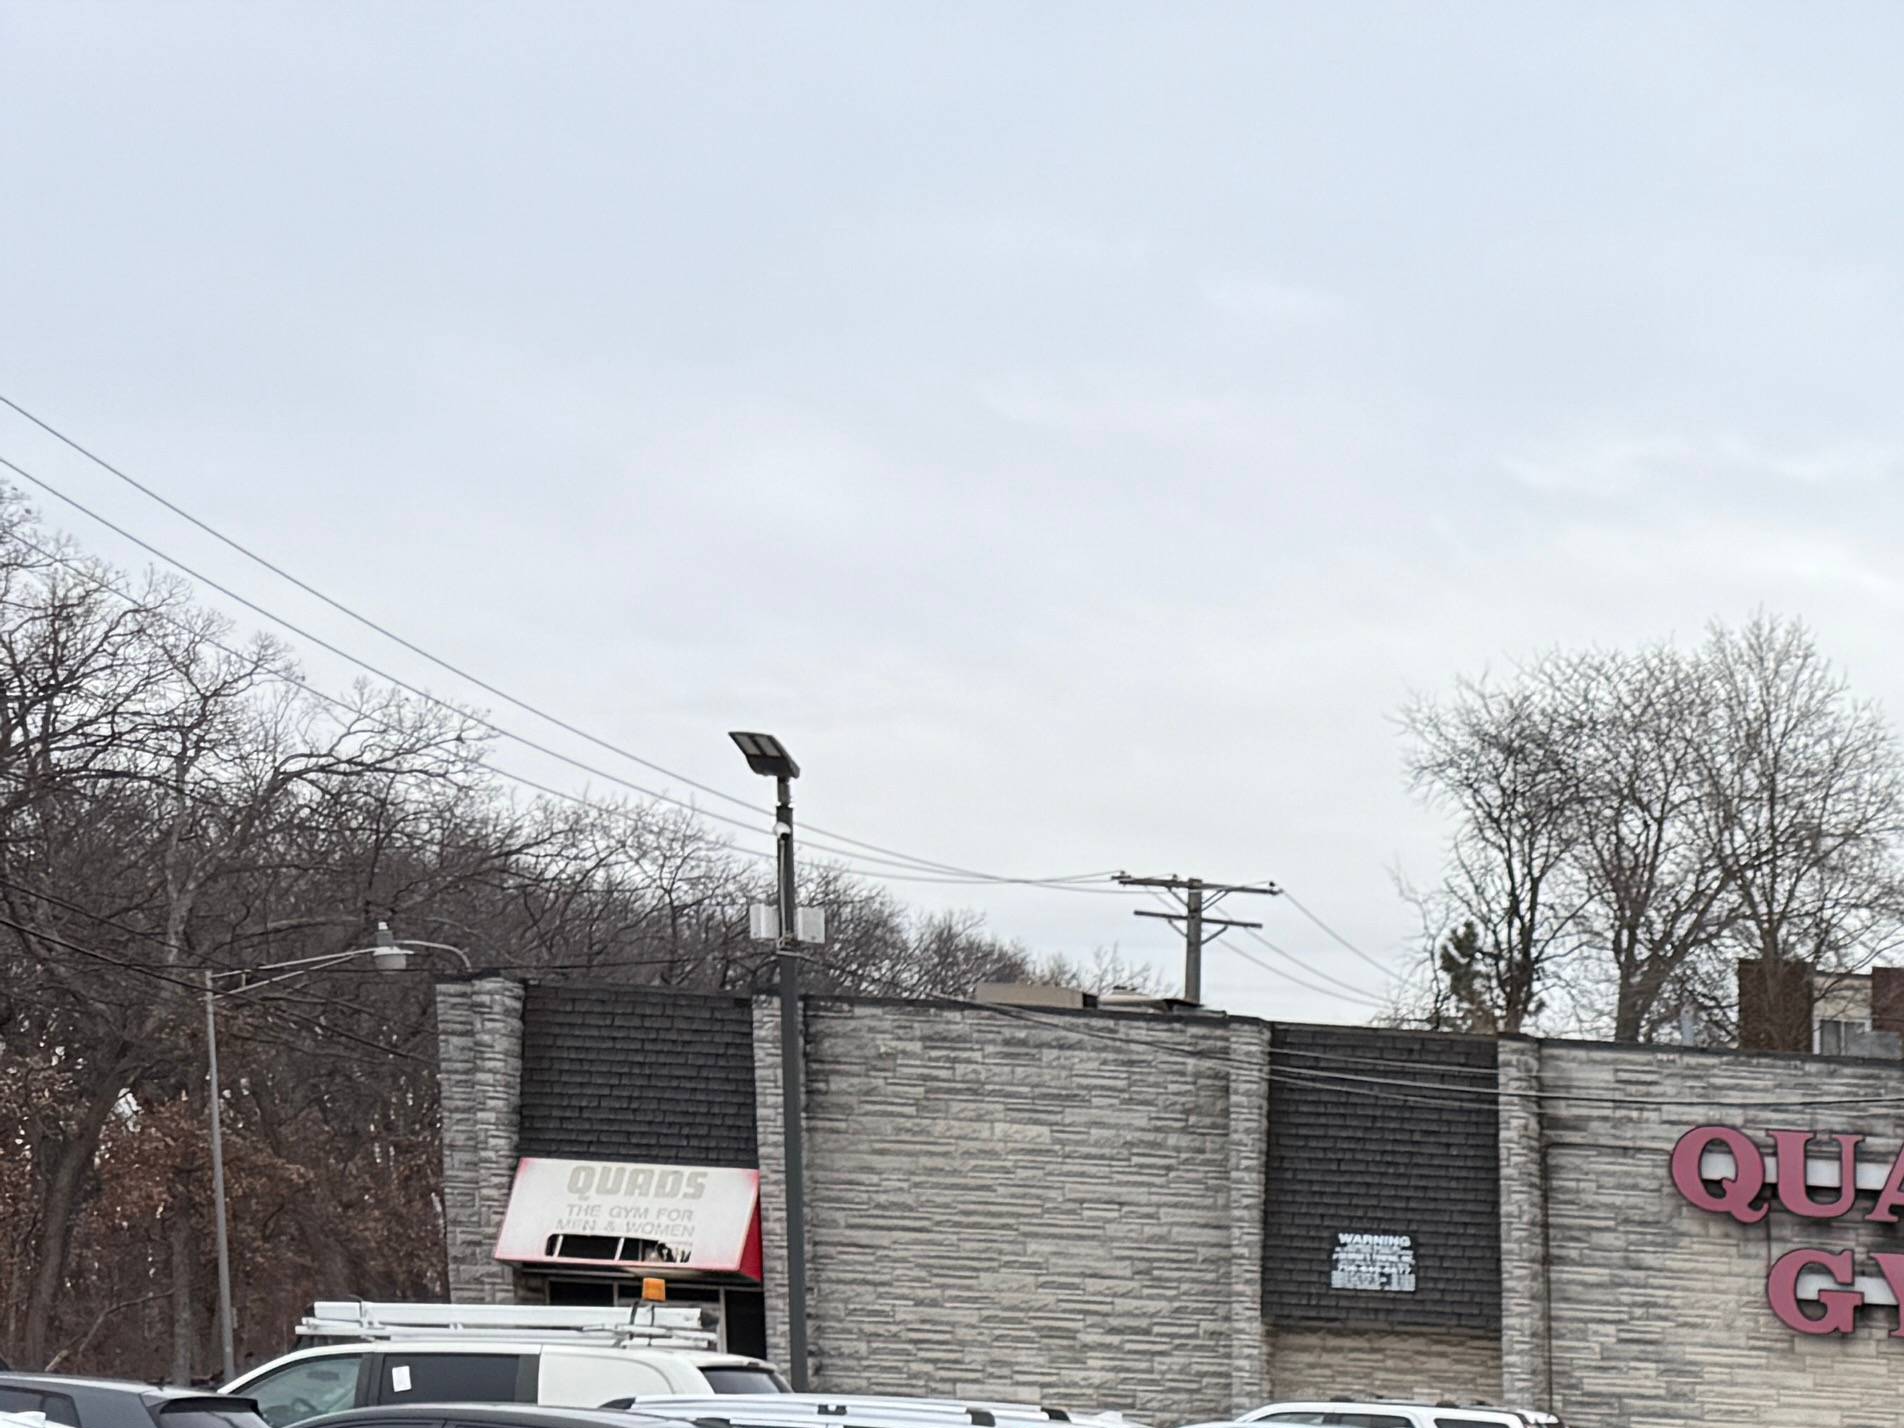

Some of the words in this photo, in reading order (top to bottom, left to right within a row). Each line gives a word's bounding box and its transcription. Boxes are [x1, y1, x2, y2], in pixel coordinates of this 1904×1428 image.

[566, 1165, 709, 1201] QUADS
[567, 1204, 600, 1218] THE
[609, 1205, 649, 1220] GYM
[656, 1208, 694, 1222] FOR
[556, 1219, 596, 1231] MEN
[626, 1221, 696, 1238] WOMEN
